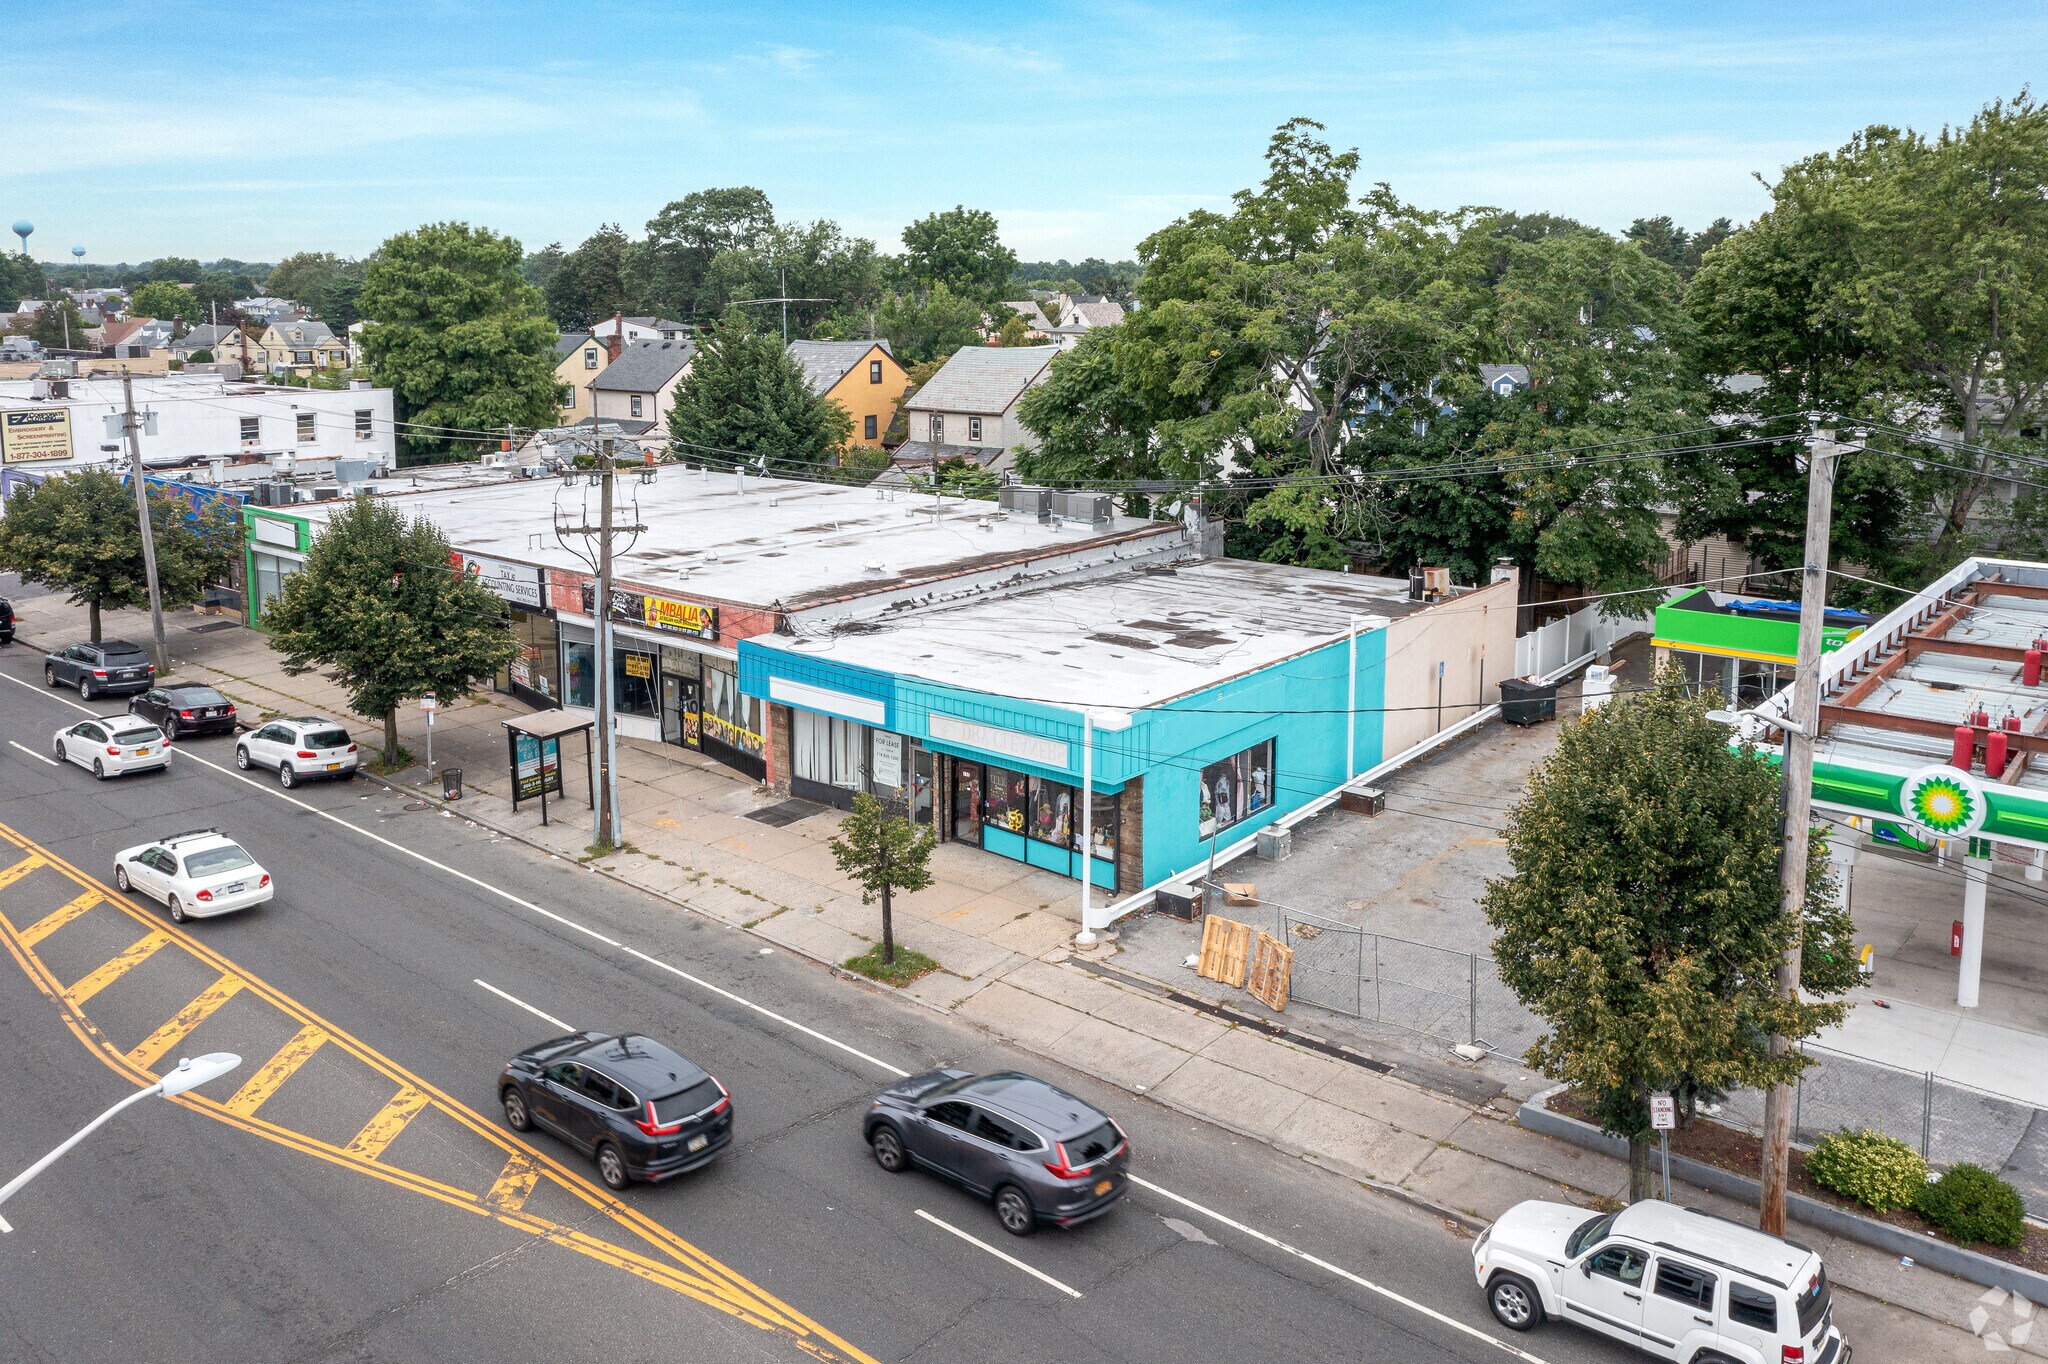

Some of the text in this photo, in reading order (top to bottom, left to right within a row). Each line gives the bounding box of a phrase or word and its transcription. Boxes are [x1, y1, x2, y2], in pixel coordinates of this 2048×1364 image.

[7, 413, 28, 426] EZ
[8, 426, 46, 434] EMBROIDERY
[17, 432, 67, 440] SCREENPRINTING
[10, 449, 68, 460] 1-877-304-1899
[515, 584, 538, 598] SERVICES
[660, 601, 698, 622] MBALIA
[875, 737, 900, 749] FOR LEASE
